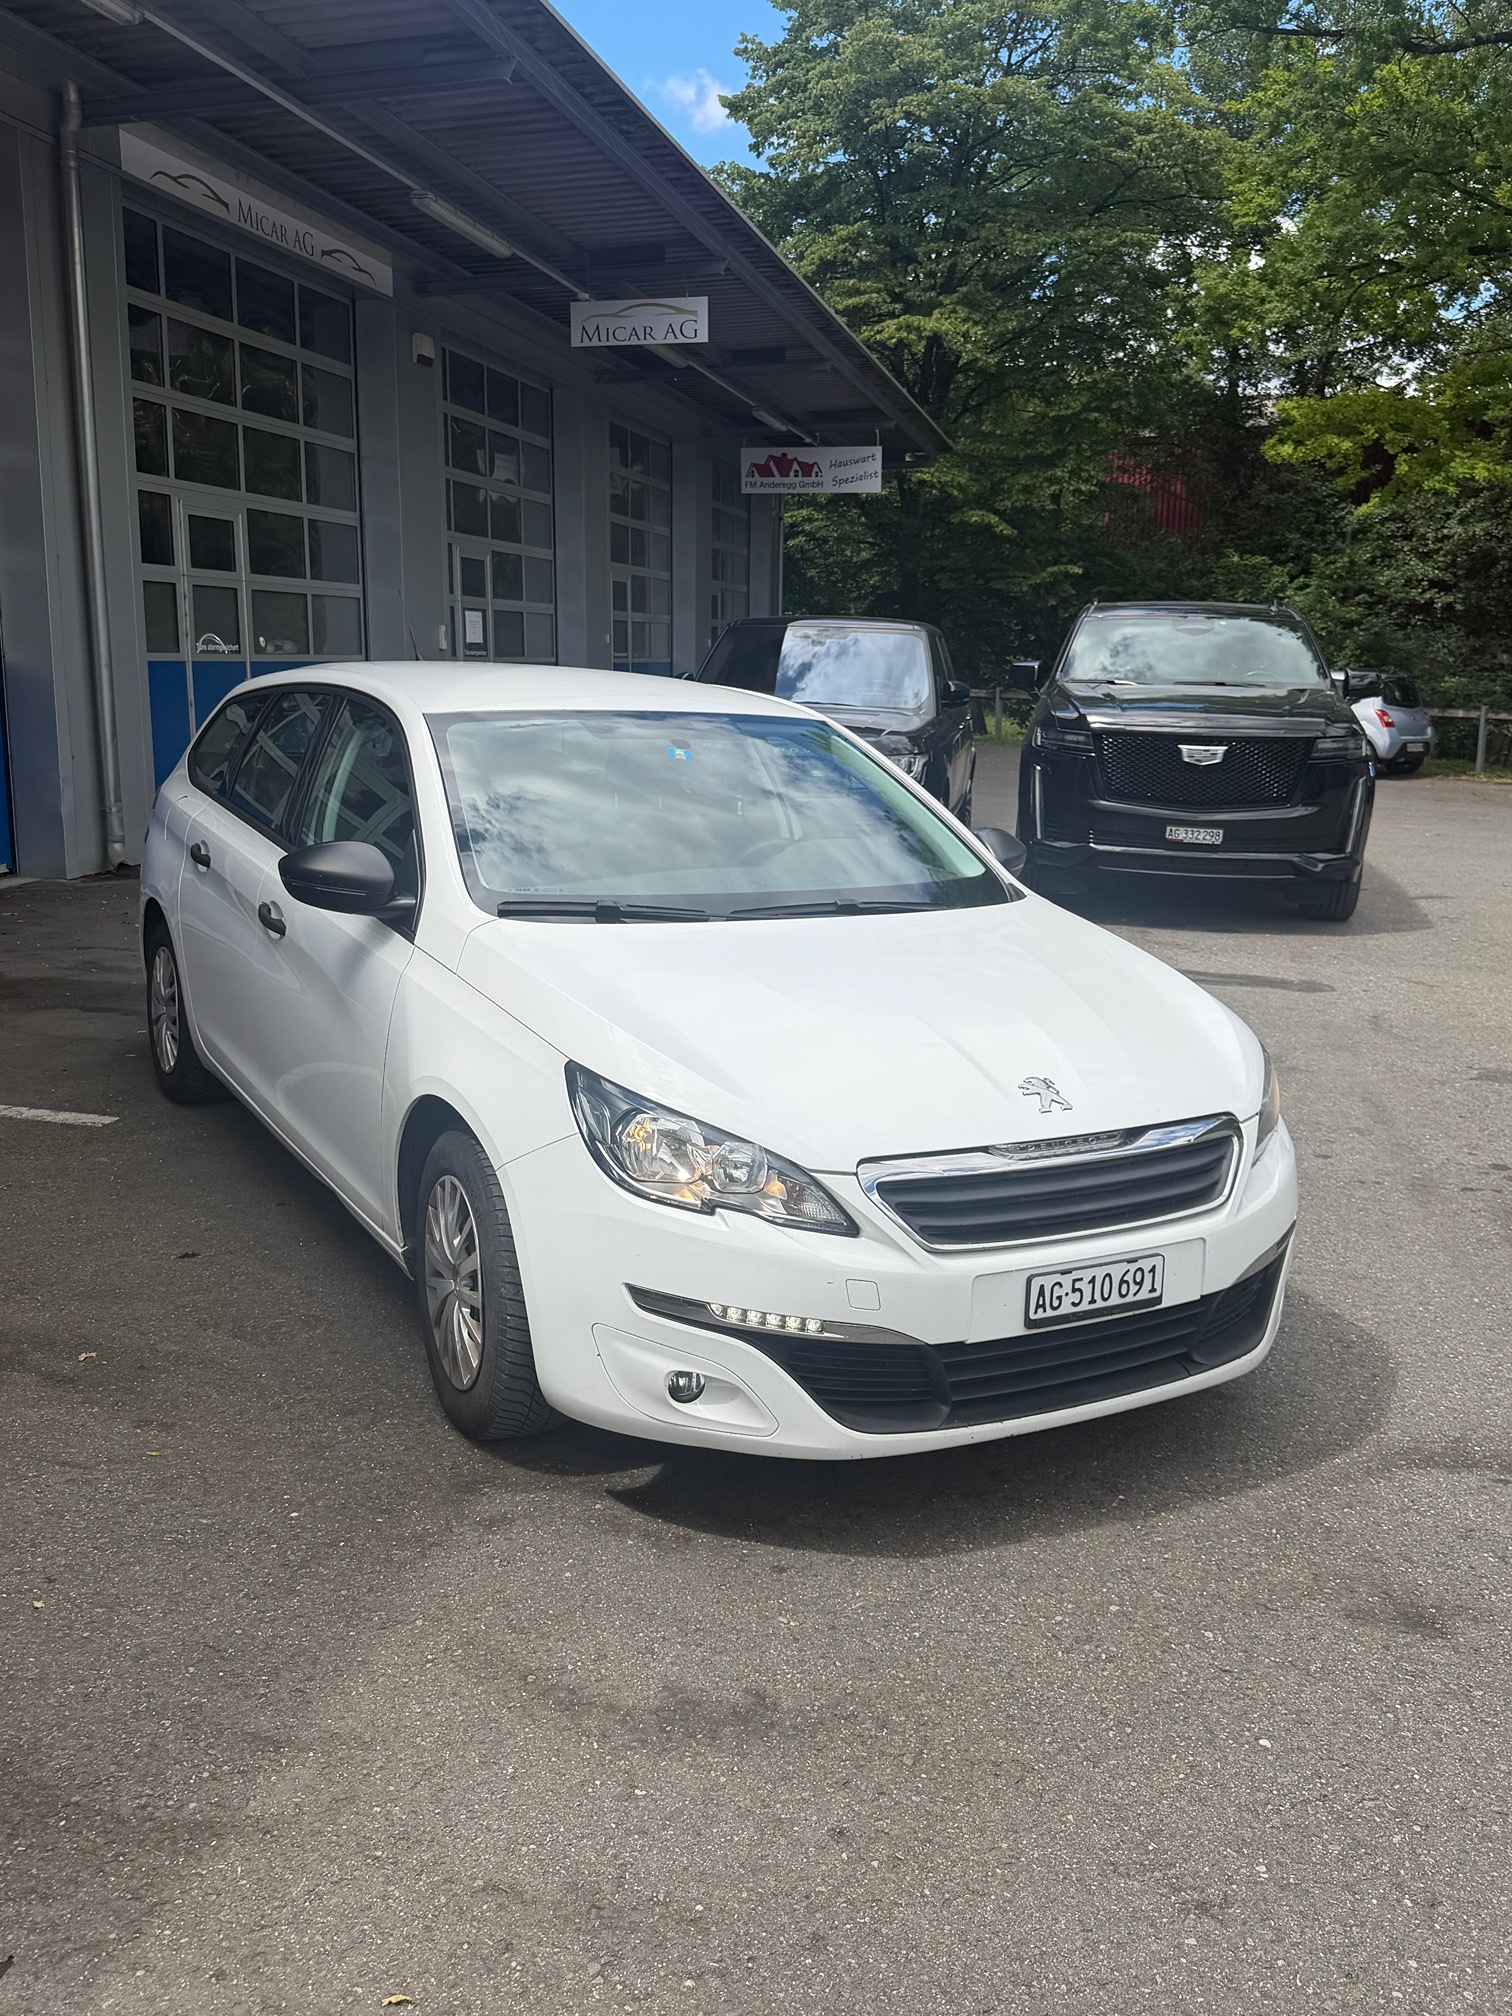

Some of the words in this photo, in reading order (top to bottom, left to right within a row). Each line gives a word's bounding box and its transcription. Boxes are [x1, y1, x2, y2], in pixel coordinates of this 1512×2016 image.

[293, 229, 314, 257] AG
[663, 320, 699, 340] AG
[828, 453, 877, 470] Hauswart
[759, 481, 797, 490] Anderegg
[798, 481, 824, 489] GmbH
[831, 470, 879, 487] Spezialist
